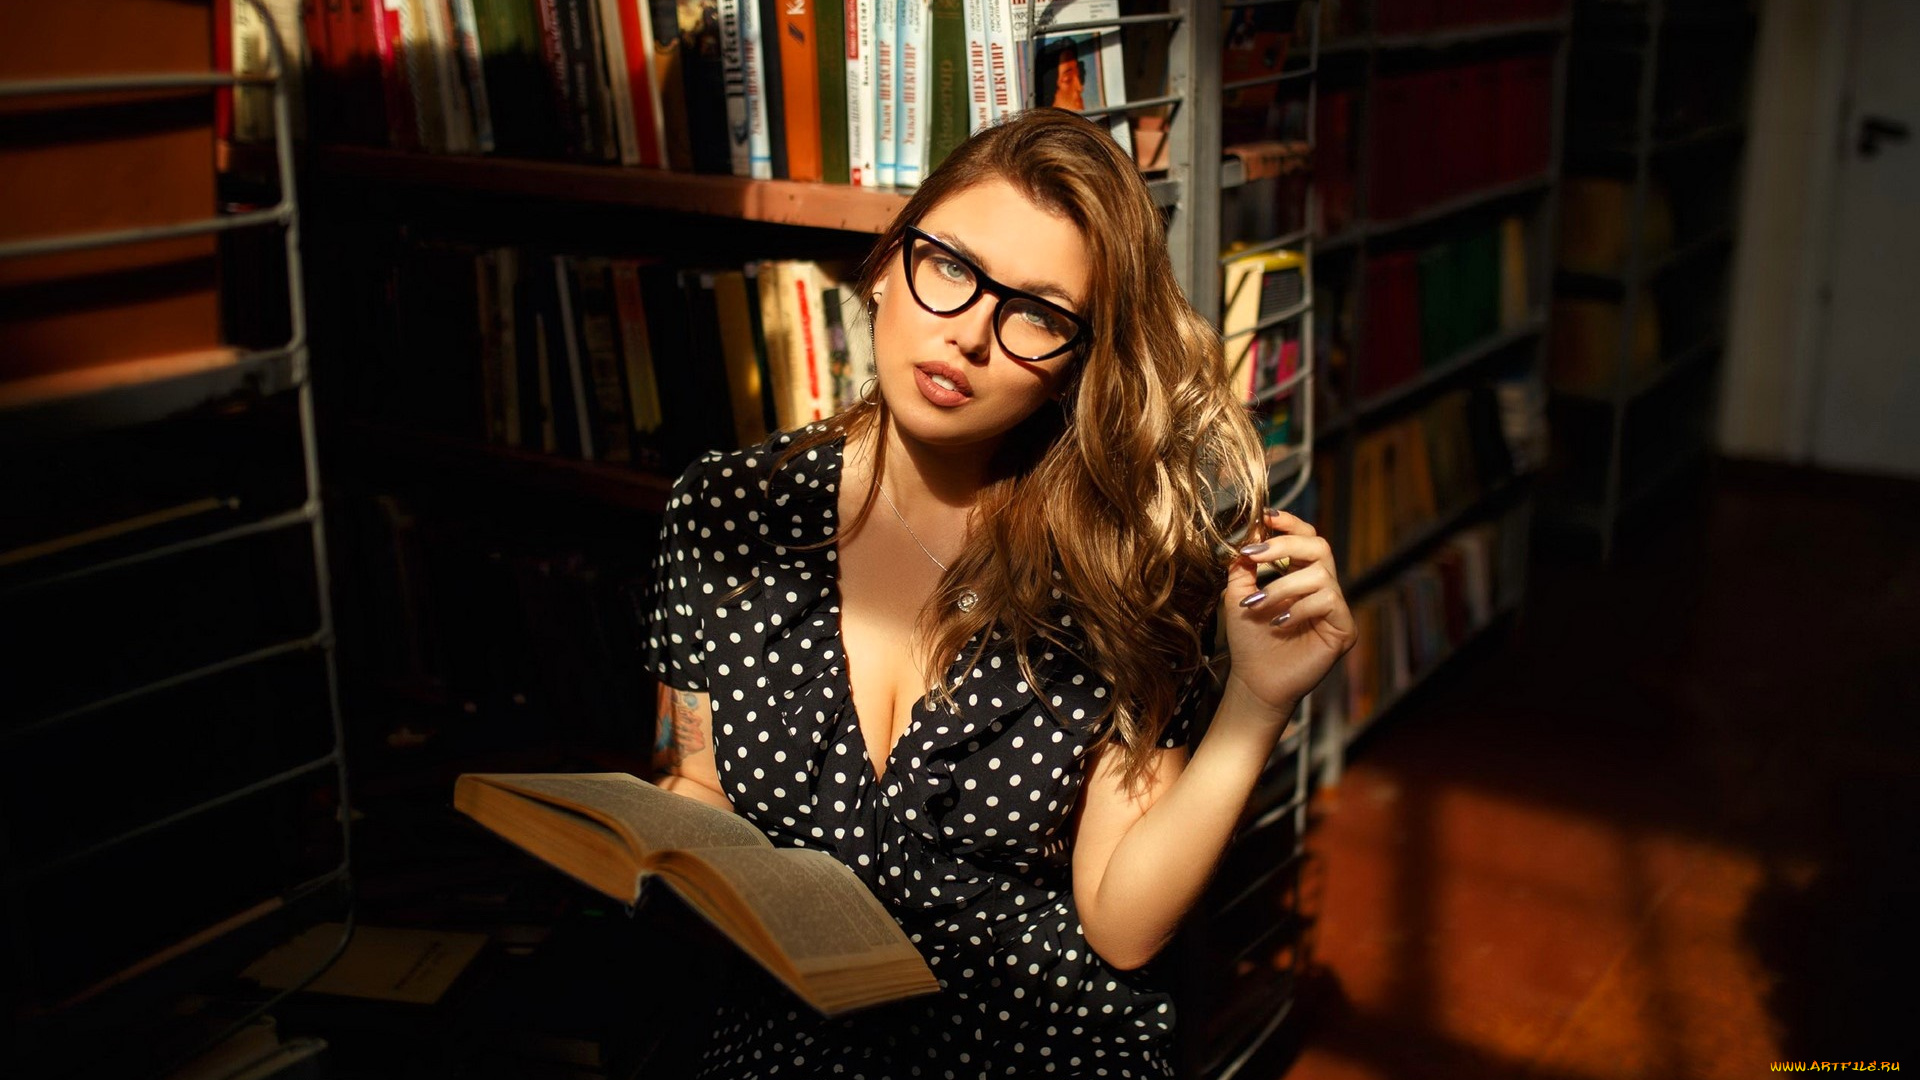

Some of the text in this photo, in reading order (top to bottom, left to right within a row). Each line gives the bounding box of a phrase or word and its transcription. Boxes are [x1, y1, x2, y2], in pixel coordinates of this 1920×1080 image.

[745, 39, 758, 96] ШЕКСПИР
[879, 40, 893, 142] Уильям ШЕКСПИР
[903, 42, 916, 104] ШЕКСПИР
[970, 40, 986, 103] ШЕКСПИР
[991, 42, 1008, 106] ШЕКСПИР
[903, 107, 916, 145] Уильям
